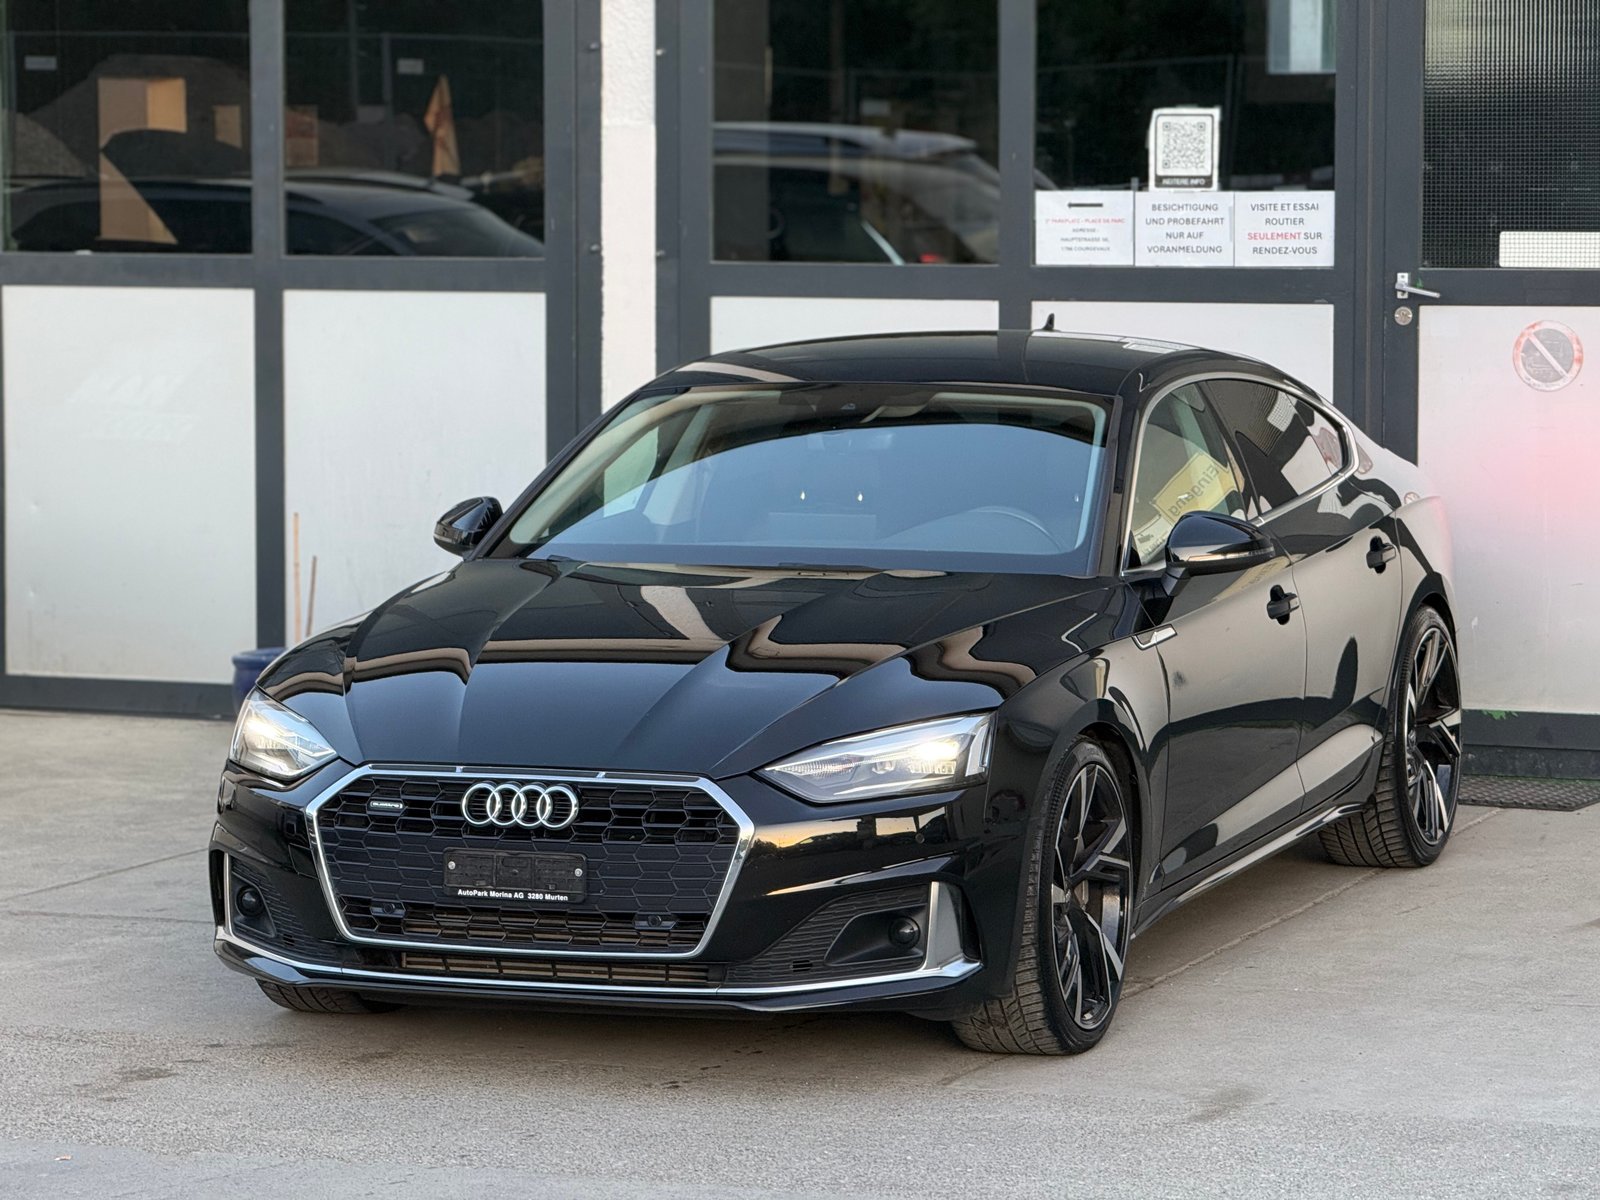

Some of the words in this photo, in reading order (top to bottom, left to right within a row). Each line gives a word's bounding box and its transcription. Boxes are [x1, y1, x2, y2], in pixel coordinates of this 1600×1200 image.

[1151, 203, 1219, 212] BESICHTIGUNG
[1250, 203, 1279, 212] VISITE
[1280, 203, 1292, 211] ET
[1293, 202, 1319, 211] ESSAI
[1145, 217, 1166, 226] UND
[1167, 217, 1225, 226] PROBEFAHRT
[1264, 217, 1305, 226] ROUTIER
[1165, 231, 1185, 240] NUR
[1186, 231, 1204, 240] AUF
[1247, 232, 1302, 241] SEULEMENT
[1303, 231, 1323, 240] SUR
[1146, 245, 1223, 254] VORANMELDUNG
[1252, 246, 1318, 255] RENDEZ-VOUS
[457, 888, 489, 898] AutoPark
[489, 891, 512, 899] Morina
[527, 892, 543, 900] 3280
[544, 893, 569, 901] Murten
